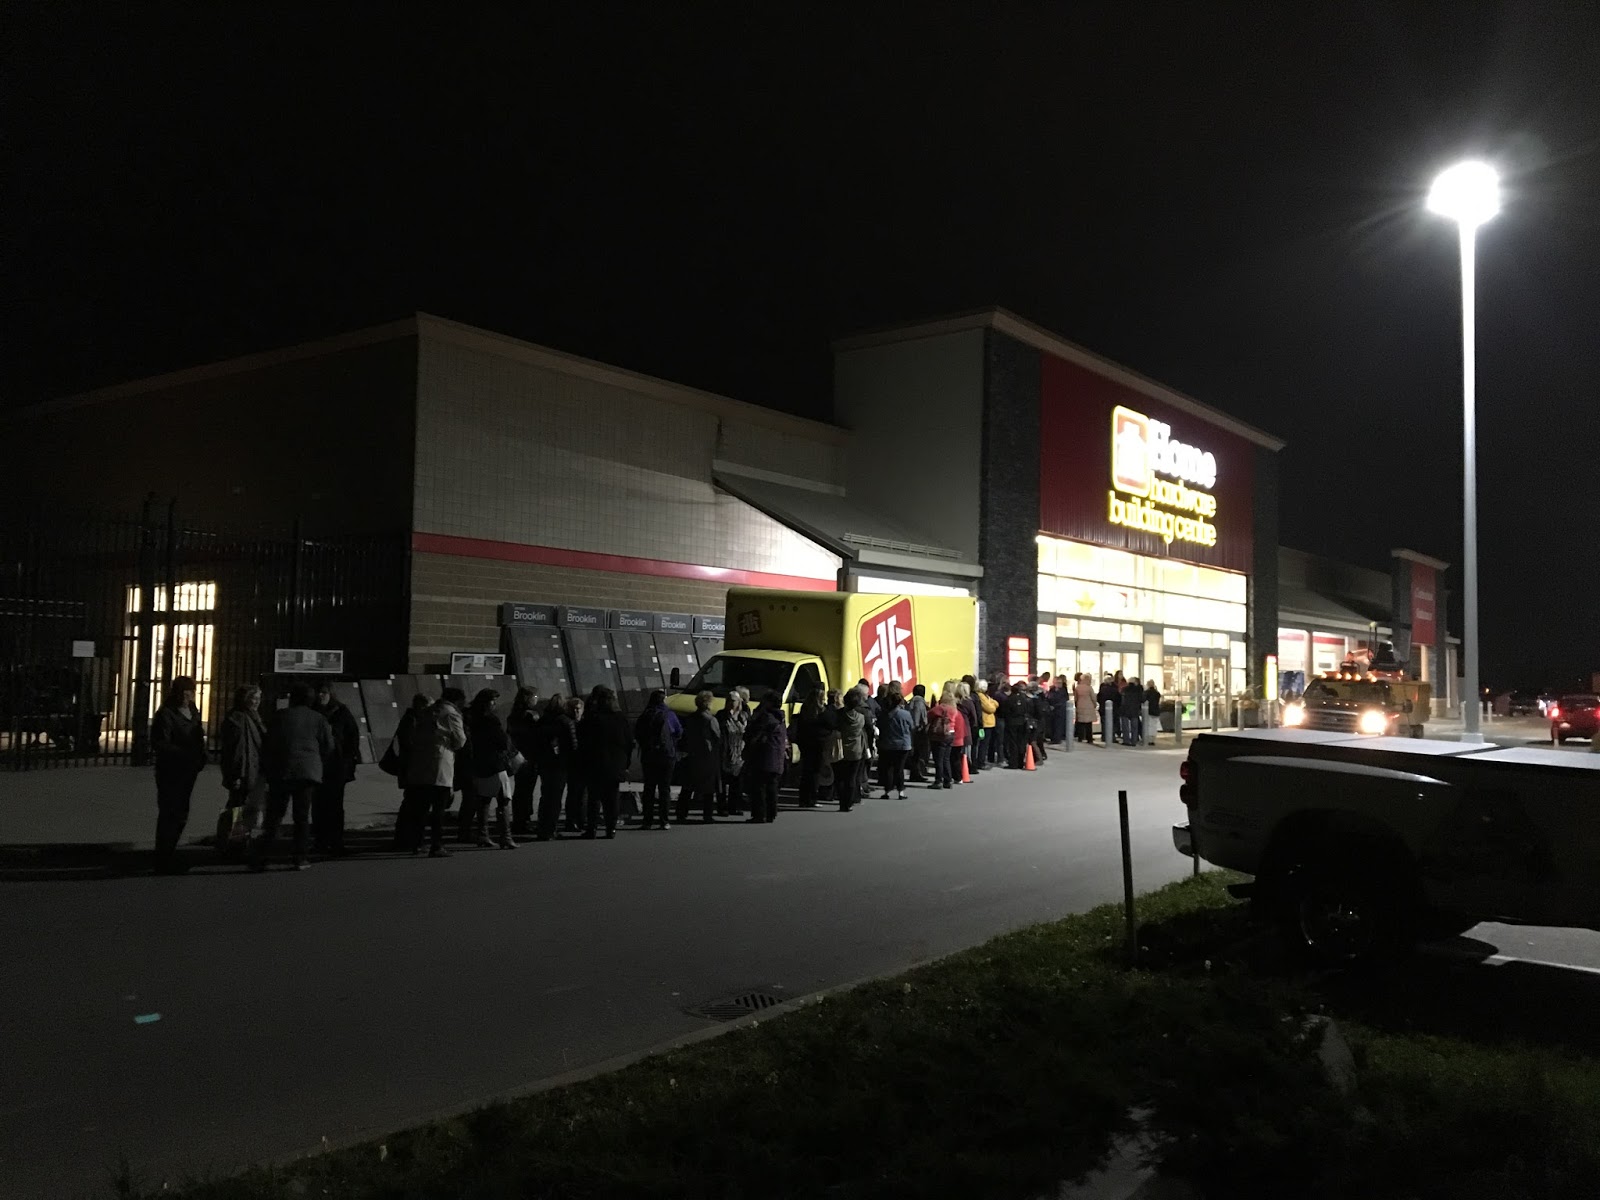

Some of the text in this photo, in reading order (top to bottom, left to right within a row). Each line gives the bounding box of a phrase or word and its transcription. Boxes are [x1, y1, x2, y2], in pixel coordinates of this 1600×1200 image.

[1149, 418, 1217, 489] Home
[1149, 470, 1217, 518] hardware
[1109, 490, 1175, 544] building
[513, 610, 546, 621] Brooklin
[567, 613, 597, 624] Brooklin
[619, 617, 647, 627] Brooklin
[661, 620, 687, 629] Brooklin
